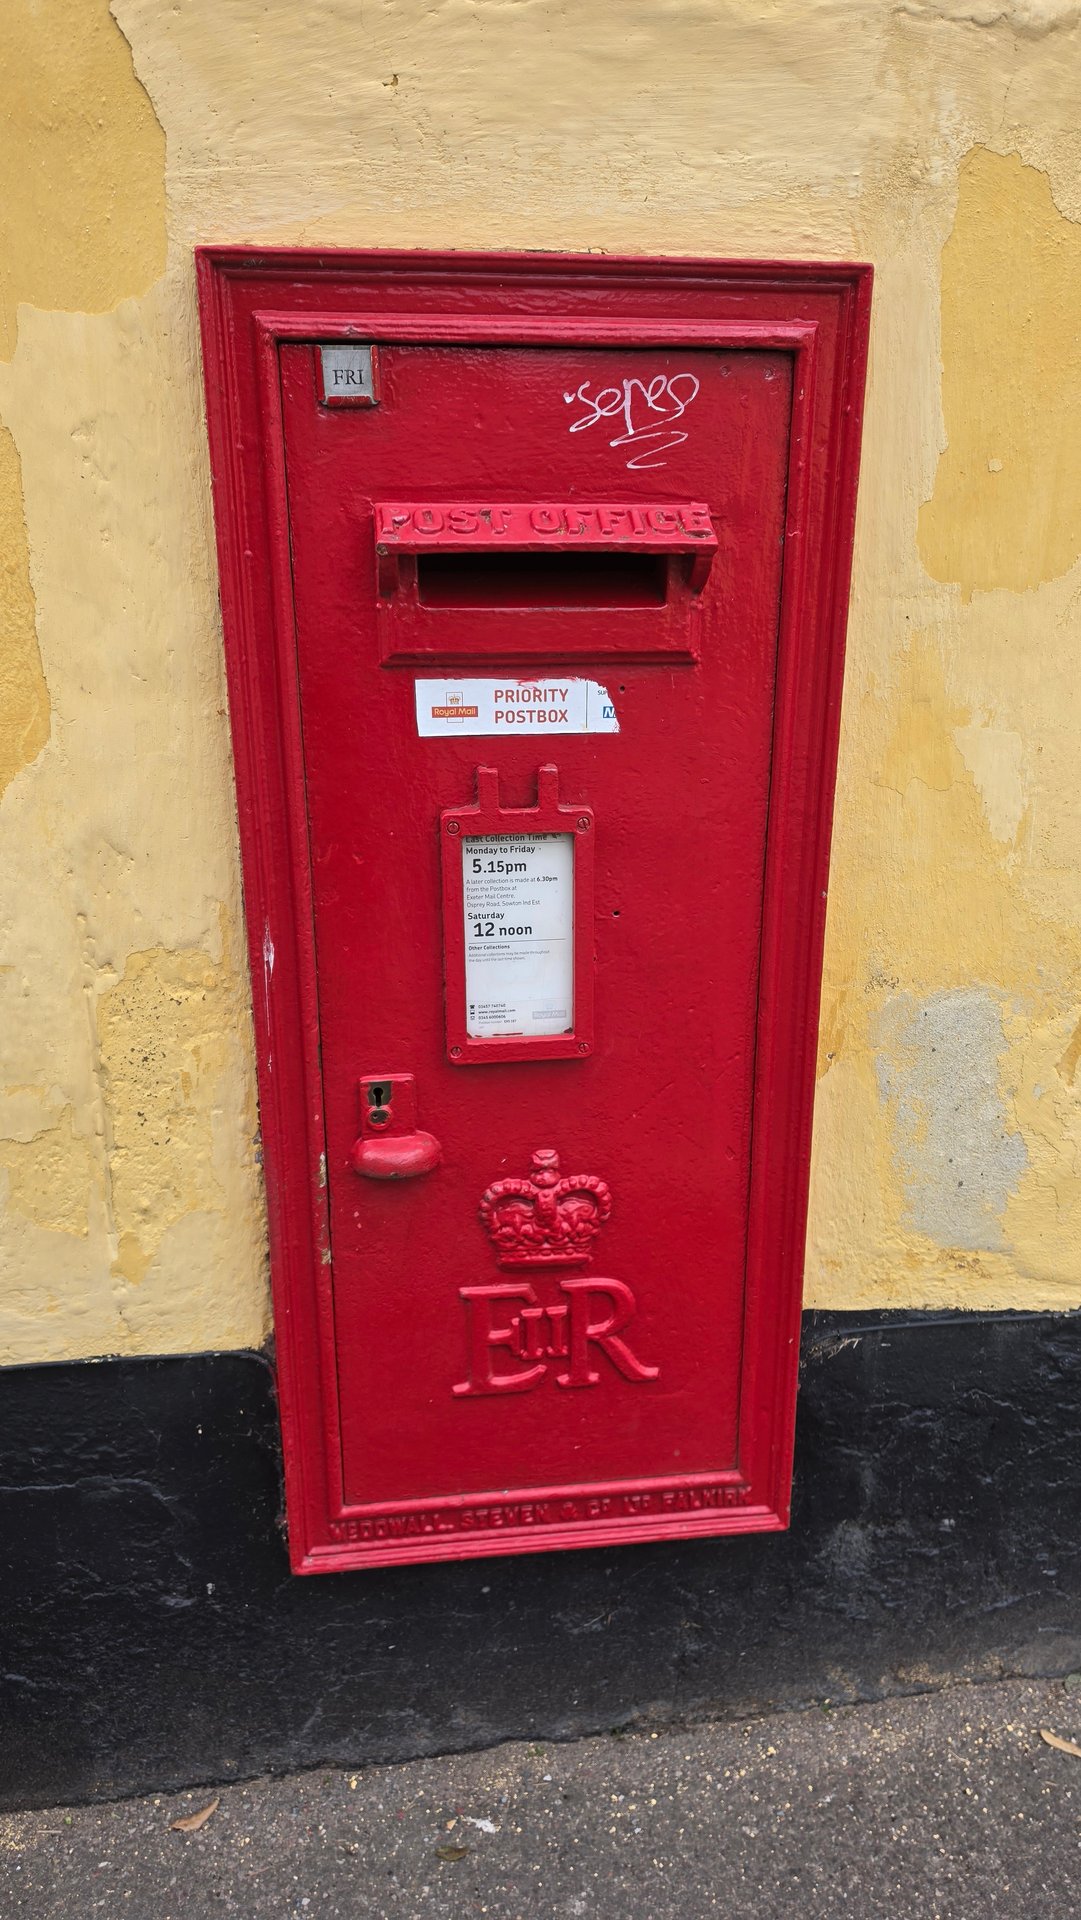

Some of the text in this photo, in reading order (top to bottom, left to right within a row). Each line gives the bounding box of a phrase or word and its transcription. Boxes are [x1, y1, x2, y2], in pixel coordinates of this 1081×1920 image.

[332, 368, 365, 387] FRI
[381, 507, 714, 537] POST OFFICE
[494, 688, 569, 703] PRIORITY
[434, 706, 476, 717] Royal Mail
[494, 709, 569, 724] POSTBOX
[485, 834, 525, 843] Collection
[527, 833, 548, 841] Time
[465, 845, 536, 855] Monday to Friday
[472, 858, 527, 875] 5.15pm
[537, 875, 558, 883] 6.30pm
[467, 911, 505, 920] Saturday
[473, 922, 533, 937] 12 noon
